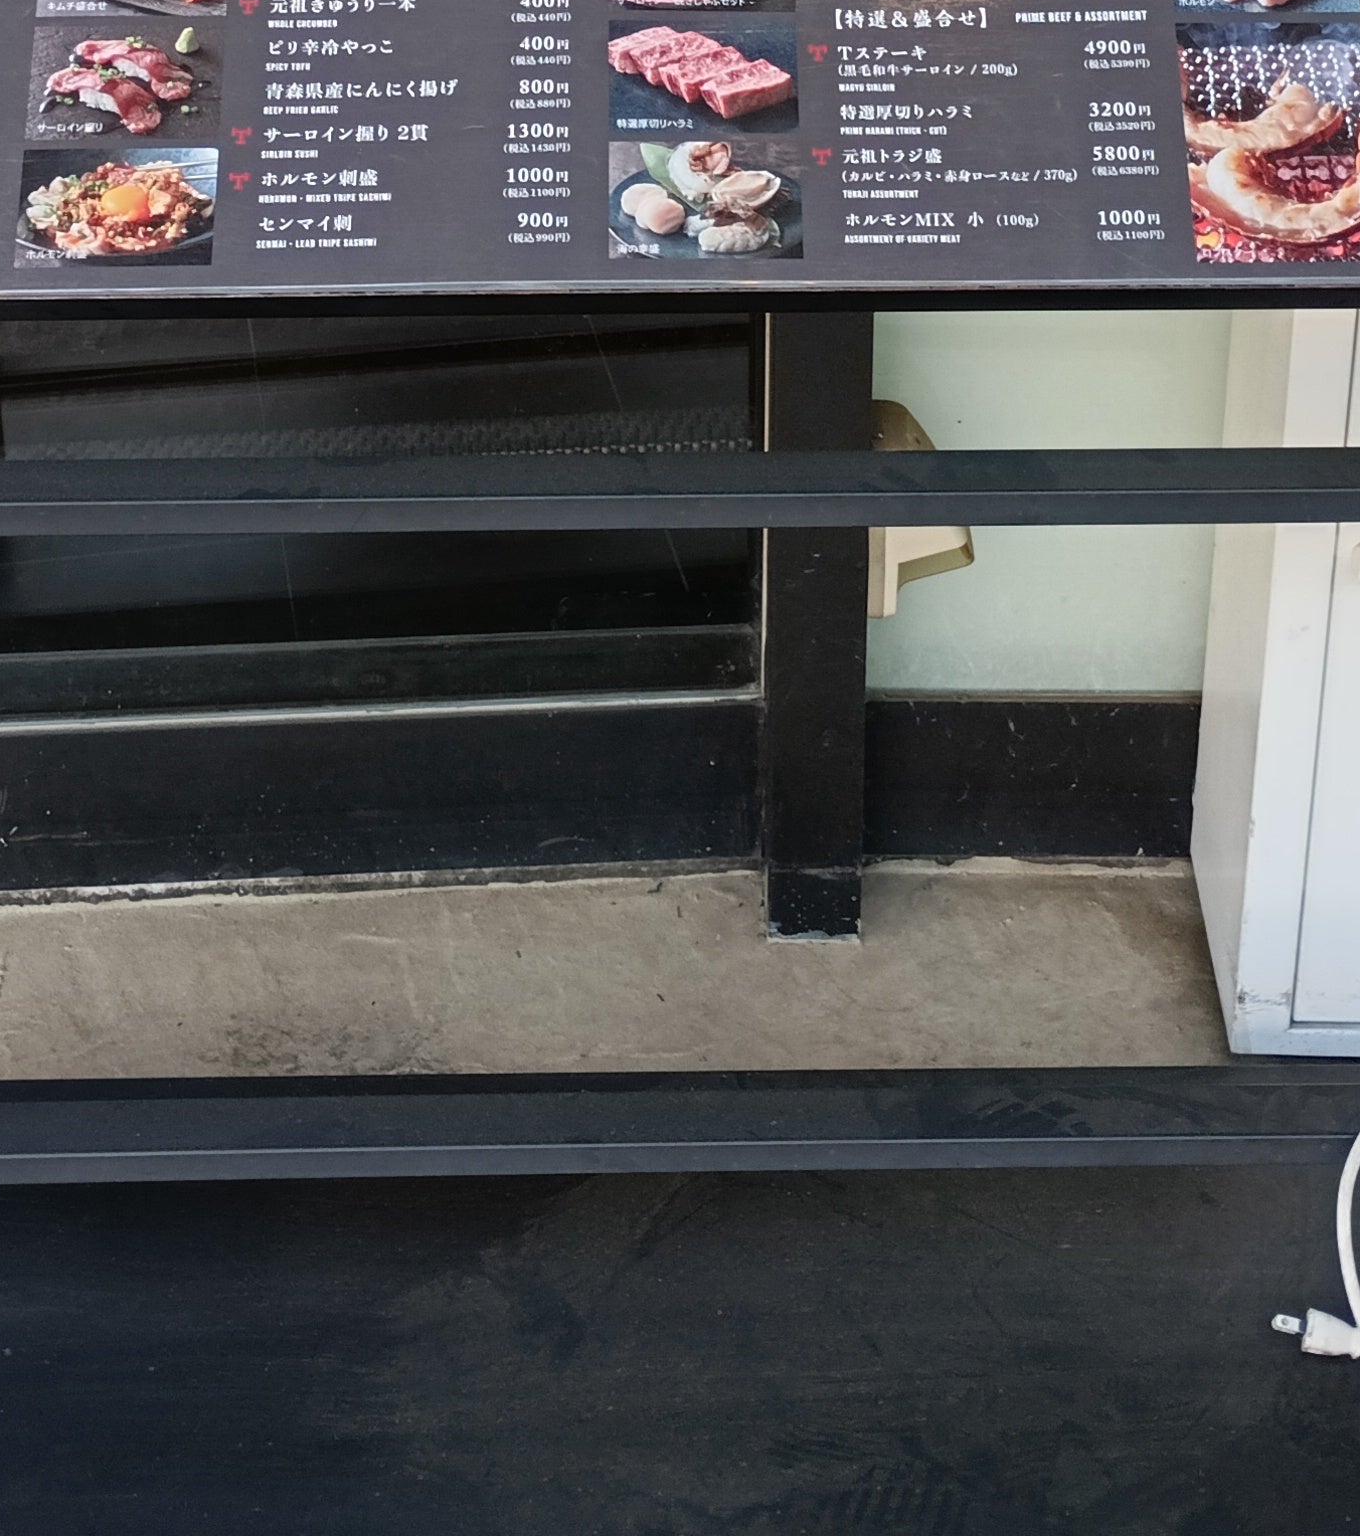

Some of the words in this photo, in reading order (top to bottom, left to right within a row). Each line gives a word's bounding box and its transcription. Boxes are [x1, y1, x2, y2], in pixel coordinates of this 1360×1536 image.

[1084, 9, 1148, 22] ASSORTMENT
[269, 38, 393, 56] ピリ辛冷やっこ
[265, 78, 459, 100] 青森県産にんにく揚げ
[519, 78, 569, 95] 800円
[839, 104, 972, 121] 特選厚切りハラミ
[1089, 101, 1152, 118] 3200円
[842, 147, 942, 164] 元祖トラジ盛
[261, 168, 378, 187] ホルモン刺盛
[506, 167, 569, 183] 1000円
[258, 214, 353, 232] センマイ刺
[1097, 209, 1161, 226] 1000円
